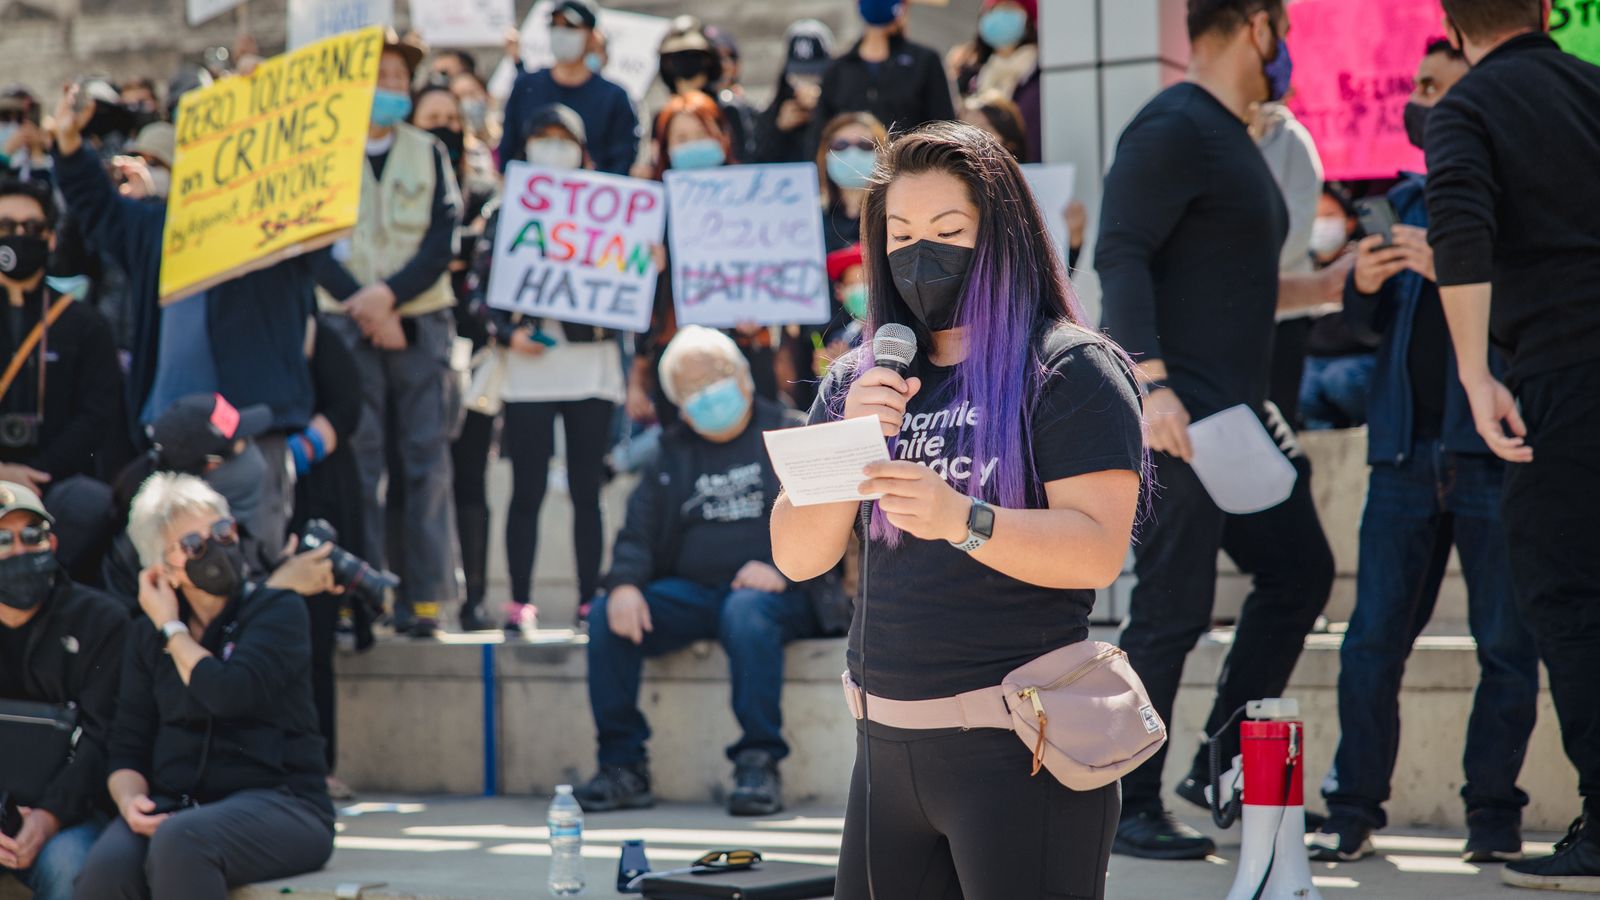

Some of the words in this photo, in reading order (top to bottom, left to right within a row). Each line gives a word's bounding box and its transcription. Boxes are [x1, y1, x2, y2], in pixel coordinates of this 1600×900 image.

[178, 91, 236, 145] ZERO
[250, 35, 378, 117] TOLERANCE
[213, 93, 342, 185] CRIMES
[251, 152, 335, 211] ANYONE
[520, 175, 657, 226] STOP
[509, 219, 651, 279] ASIAN
[514, 264, 640, 316] HATE
[682, 258, 825, 304] HATRED
